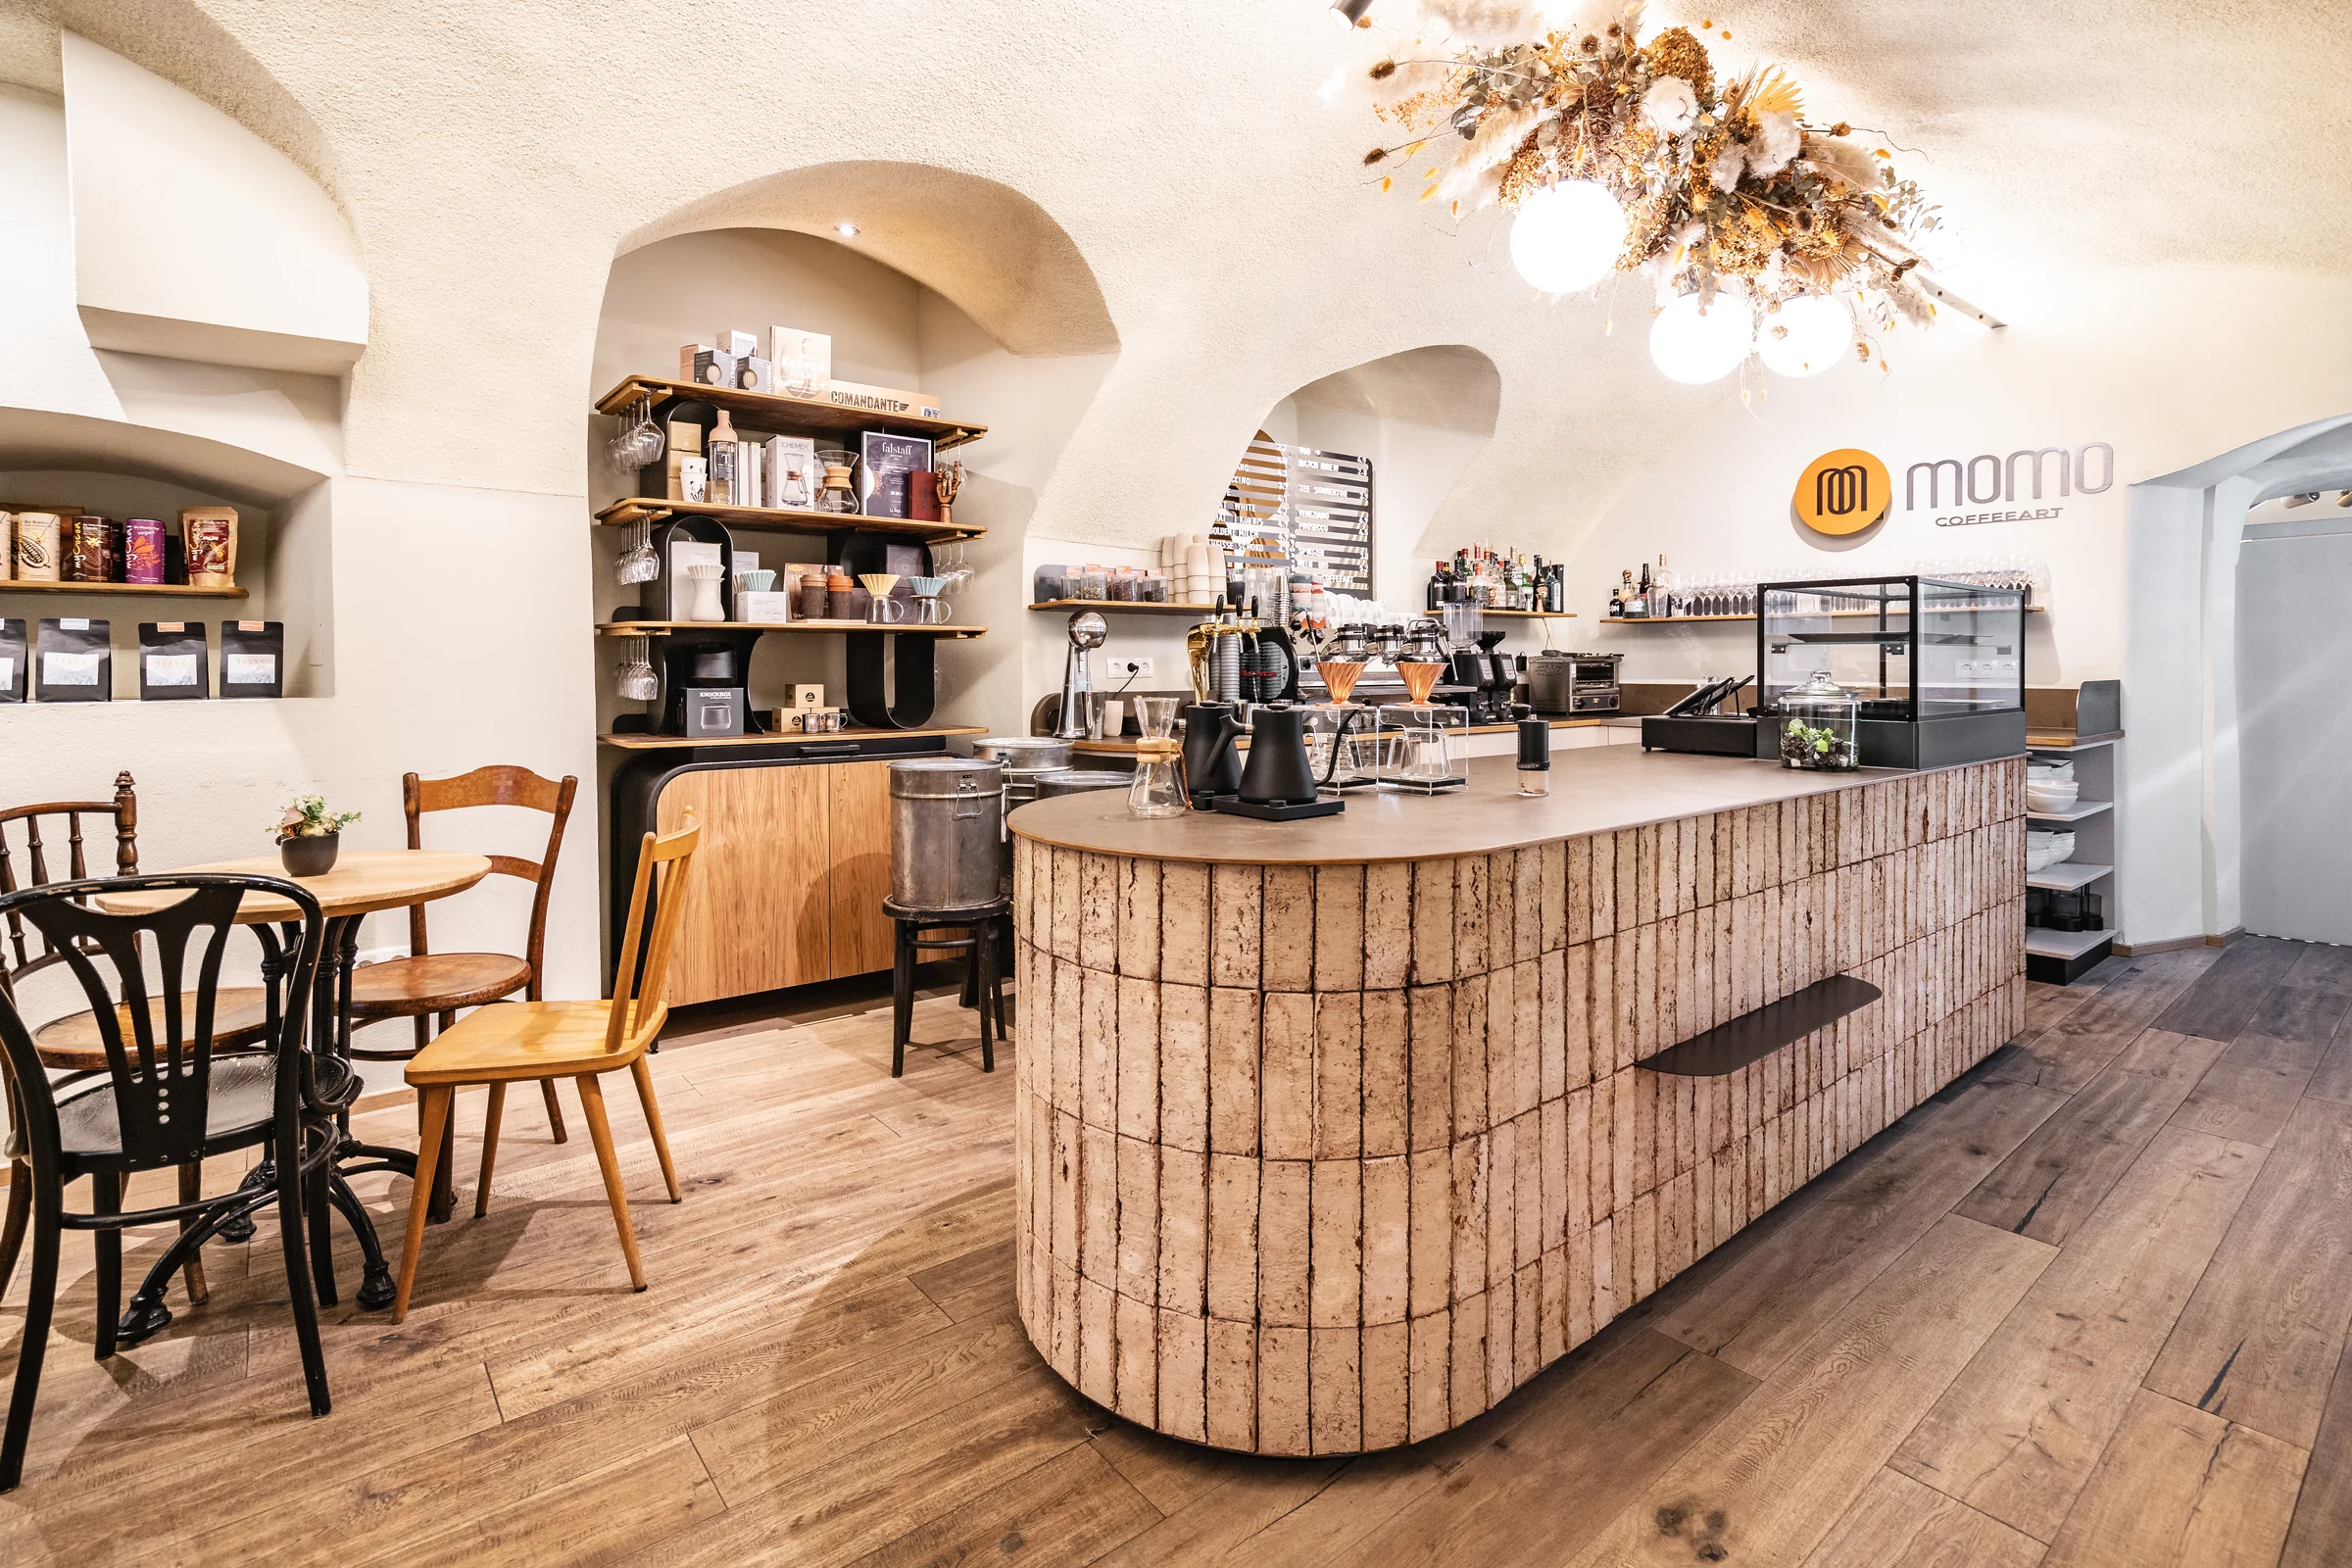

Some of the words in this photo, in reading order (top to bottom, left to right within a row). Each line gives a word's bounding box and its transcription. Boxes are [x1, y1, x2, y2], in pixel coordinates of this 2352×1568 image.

[831, 390, 899, 413] COMANDANTE
[781, 441, 808, 450] CHEMEX
[882, 442, 912, 456] falstaff
[1298, 460, 1319, 469] BATCH
[1320, 463, 1339, 472] BREW
[1906, 442, 2114, 511] momo
[1298, 484, 1311, 493] TEE
[1234, 502, 1255, 512] WHITE
[1936, 507, 2064, 527] COFFEEART
[1298, 521, 1329, 532] PROSECCO
[73, 521, 87, 568] myCocoa
[125, 525, 137, 569] myChai
